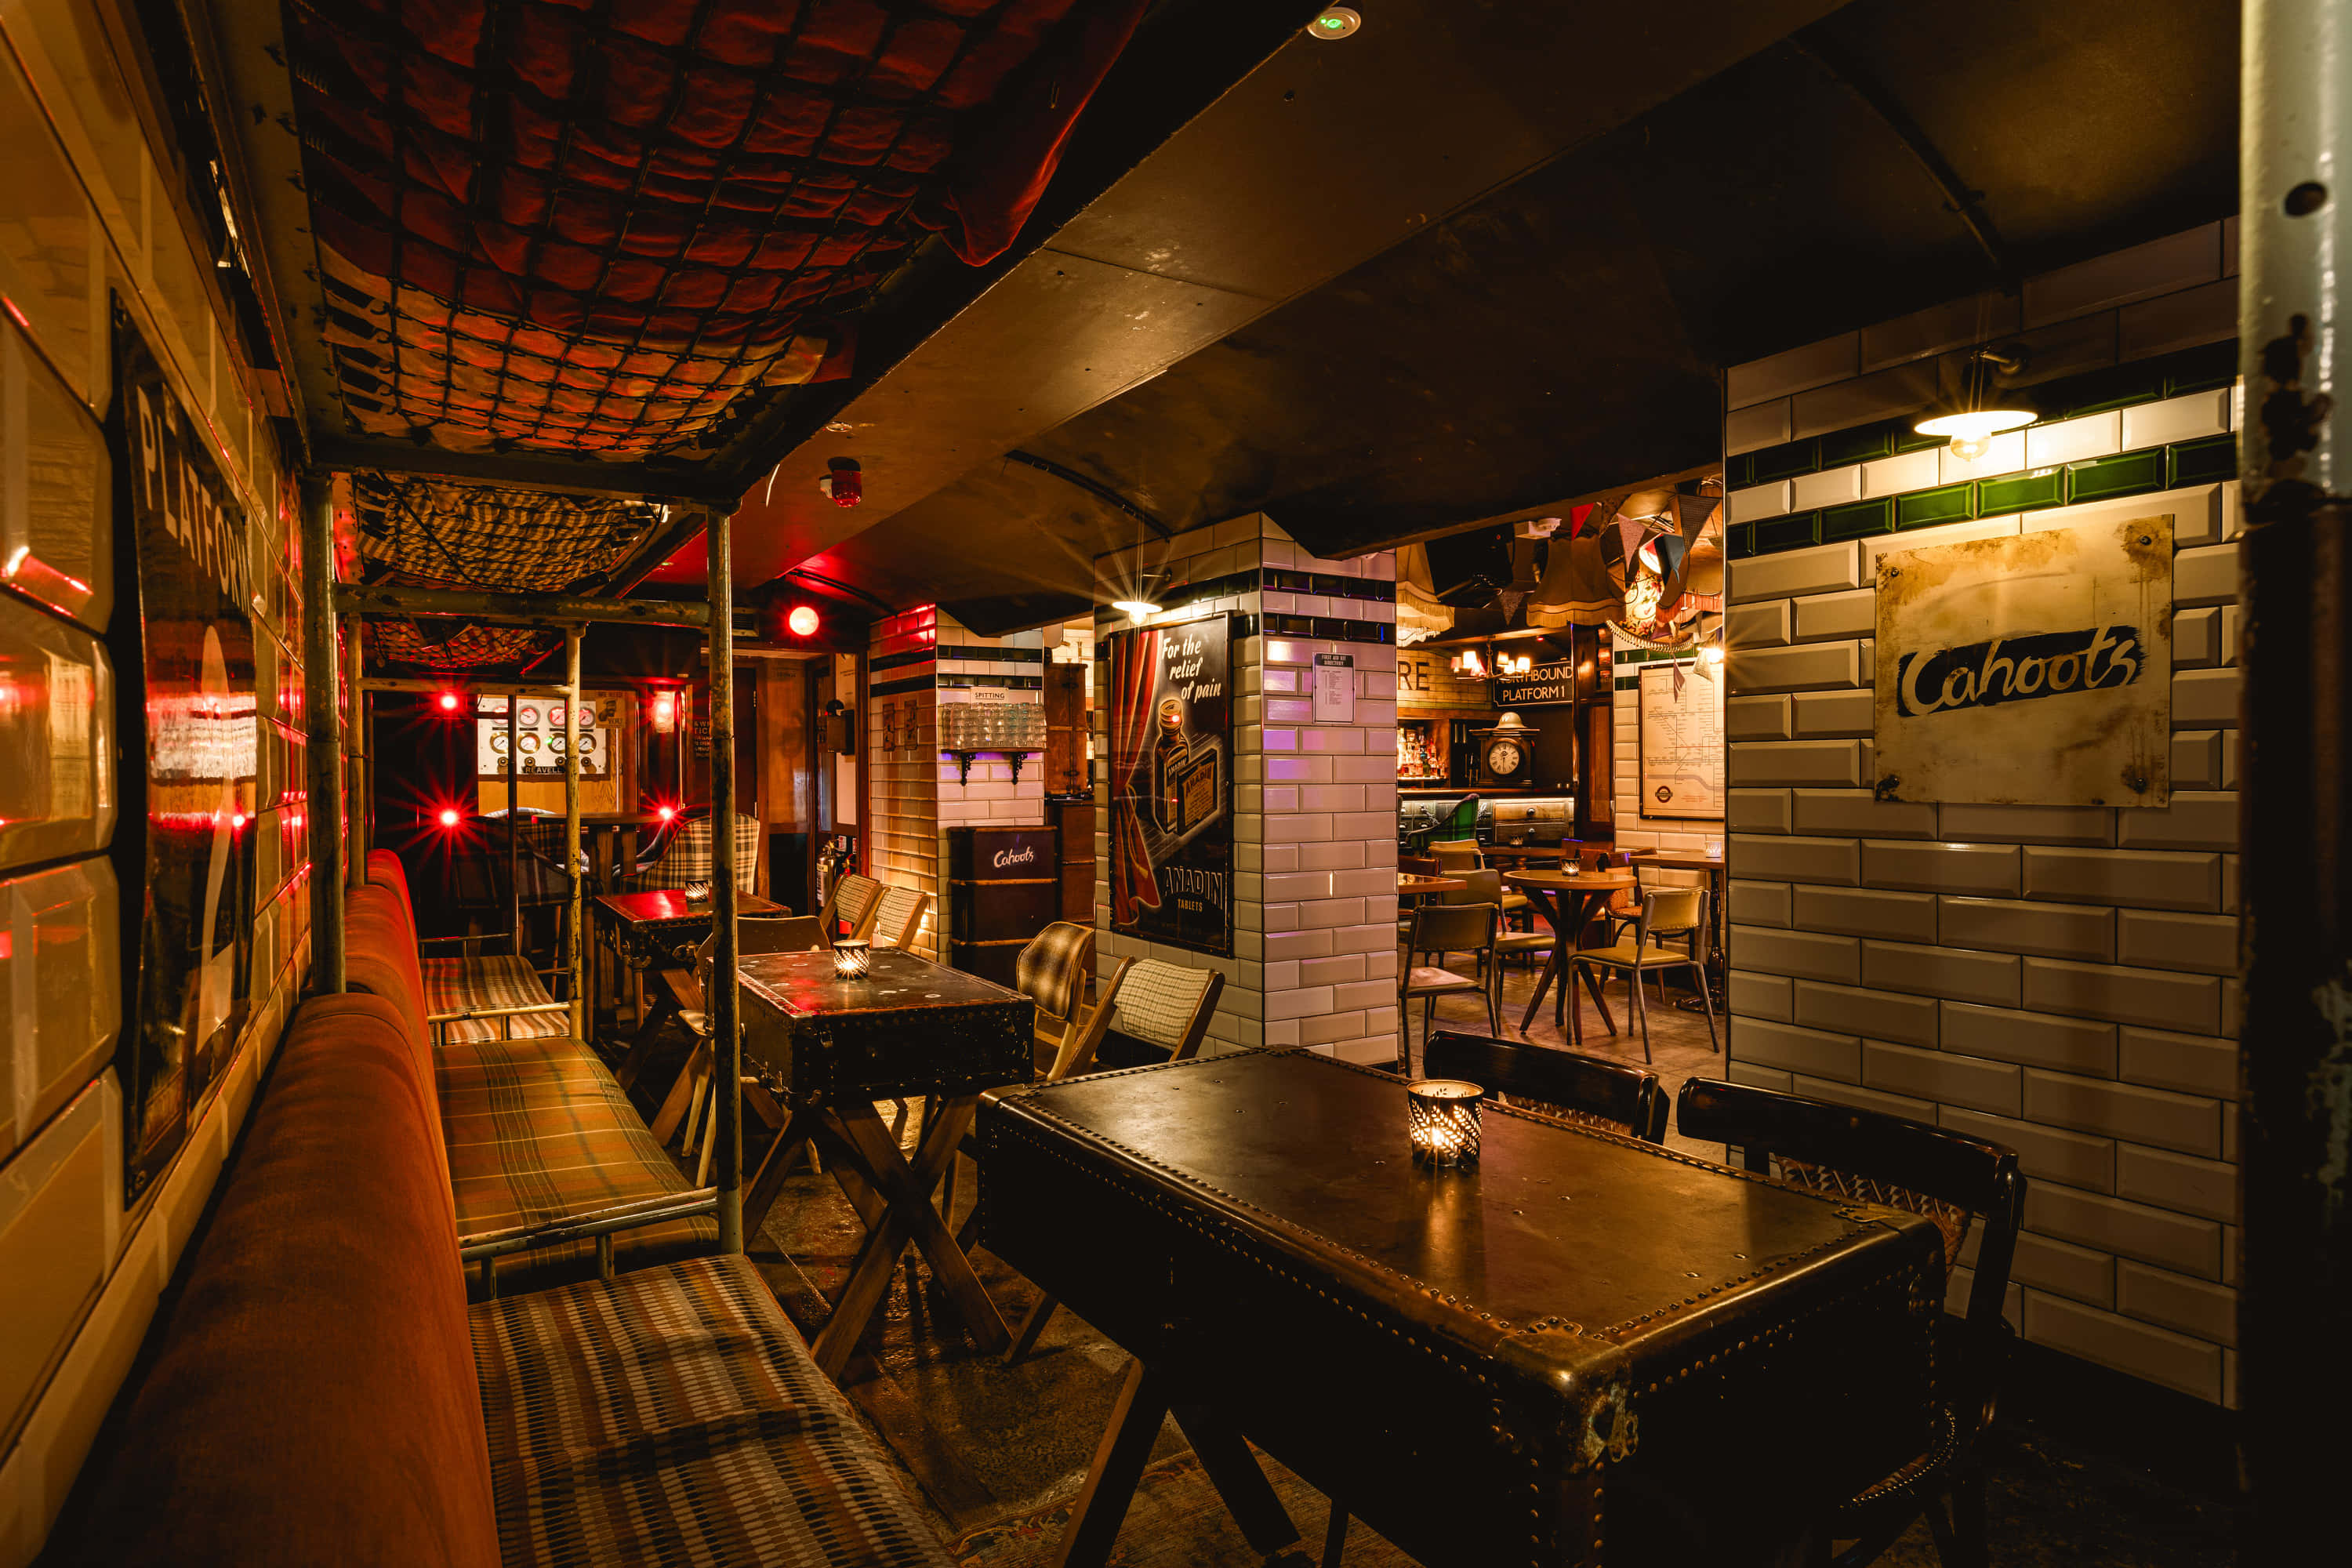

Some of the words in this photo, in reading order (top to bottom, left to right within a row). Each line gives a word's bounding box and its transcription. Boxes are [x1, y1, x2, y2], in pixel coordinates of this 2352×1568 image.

[136, 383, 252, 619] PLATFORM
[1161, 637, 1180, 659] For
[1182, 633, 1202, 656] the
[1169, 656, 1203, 681] relief
[1900, 625, 2138, 717] Cahoots
[1181, 680, 1195, 700] of
[1194, 677, 1221, 704] pain
[1502, 685, 1559, 702] PLATFORM
[993, 846, 1035, 869] Cahoots
[1164, 866, 1223, 910] ANADIN
[1177, 898, 1203, 913] TABLETS
